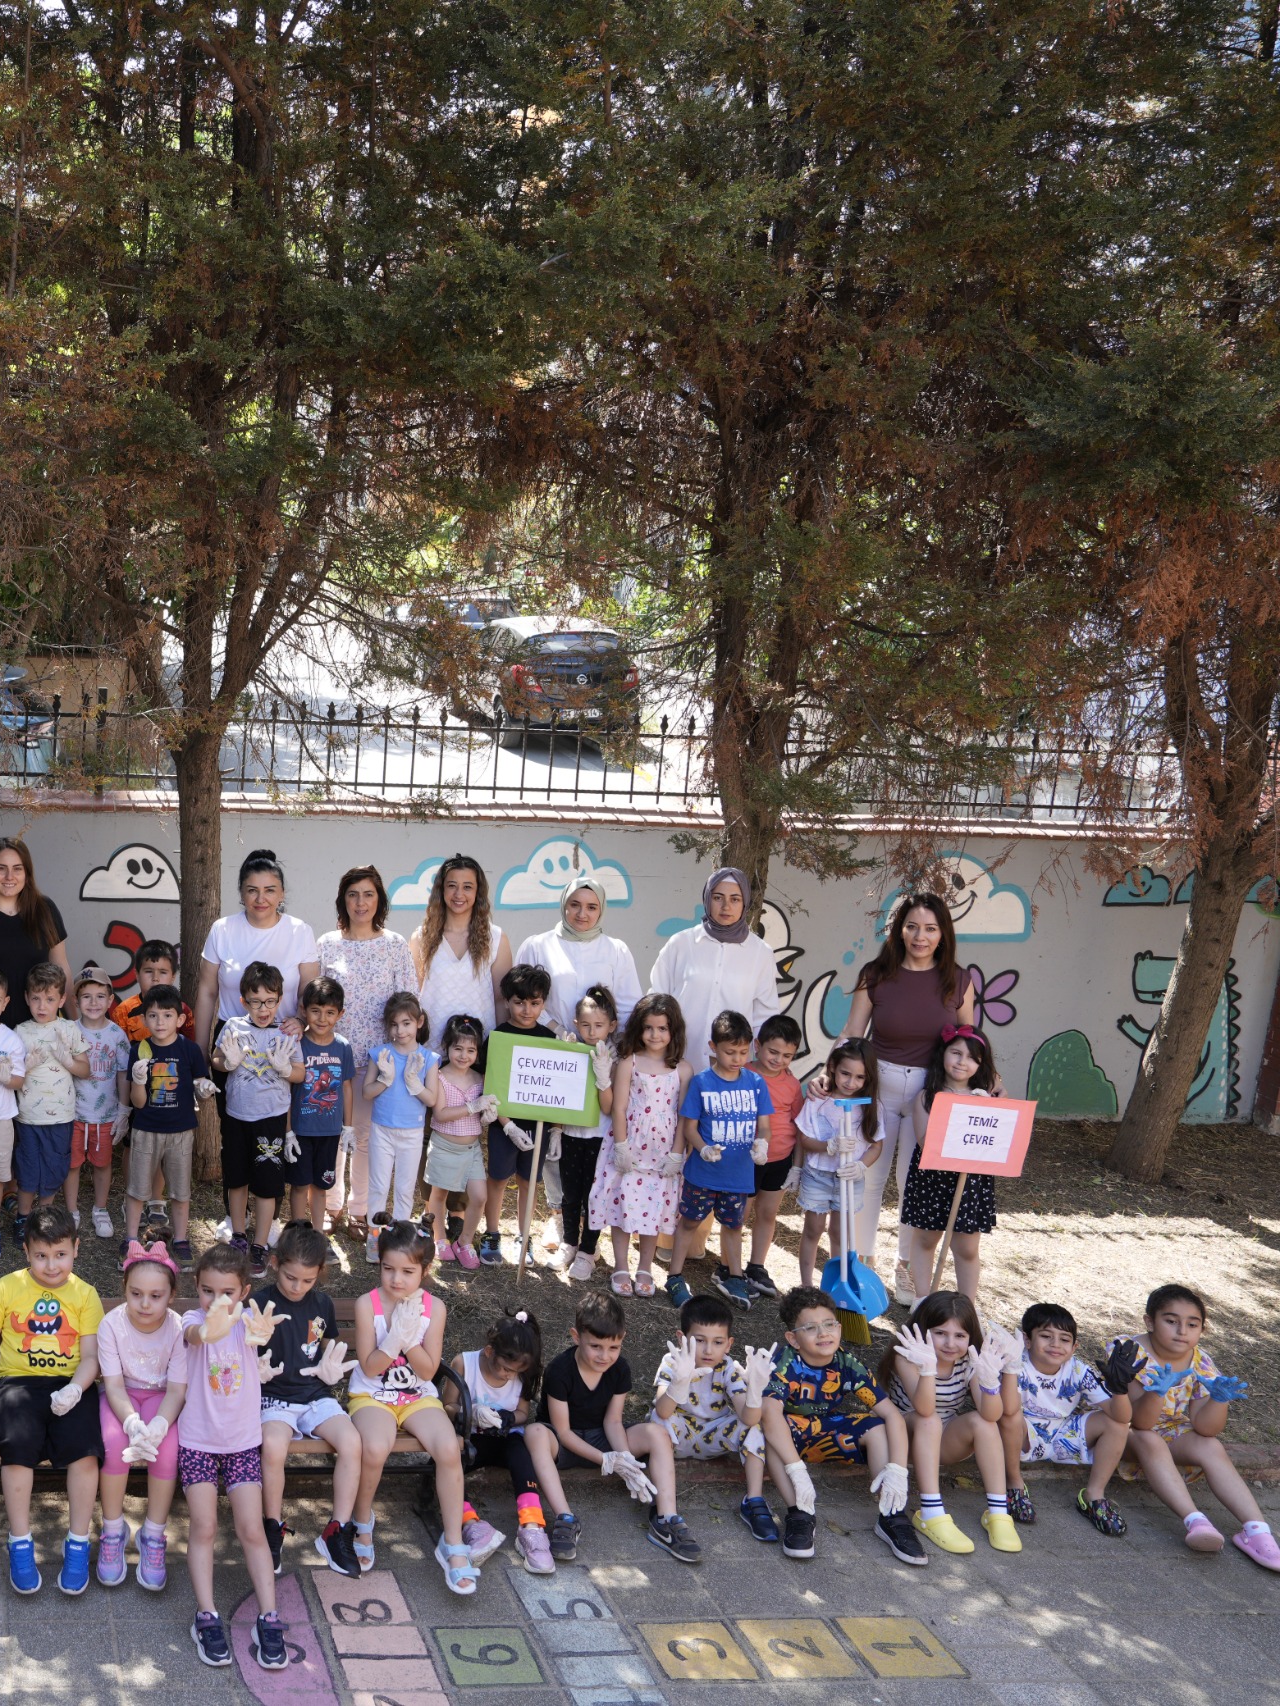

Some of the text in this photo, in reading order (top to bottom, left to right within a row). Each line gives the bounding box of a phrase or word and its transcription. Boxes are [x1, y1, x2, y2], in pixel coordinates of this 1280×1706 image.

[518, 1058, 578, 1073] ÇEVREMİZİ
[517, 1074, 551, 1087] TEMİZ
[516, 1091, 565, 1106] TUTALIM
[701, 1089, 760, 1115] TROUBL
[968, 1116, 999, 1128] TEMİZ
[963, 1134, 995, 1145] ÇEVRE
[668, 1636, 934, 1661] 3 2 1
